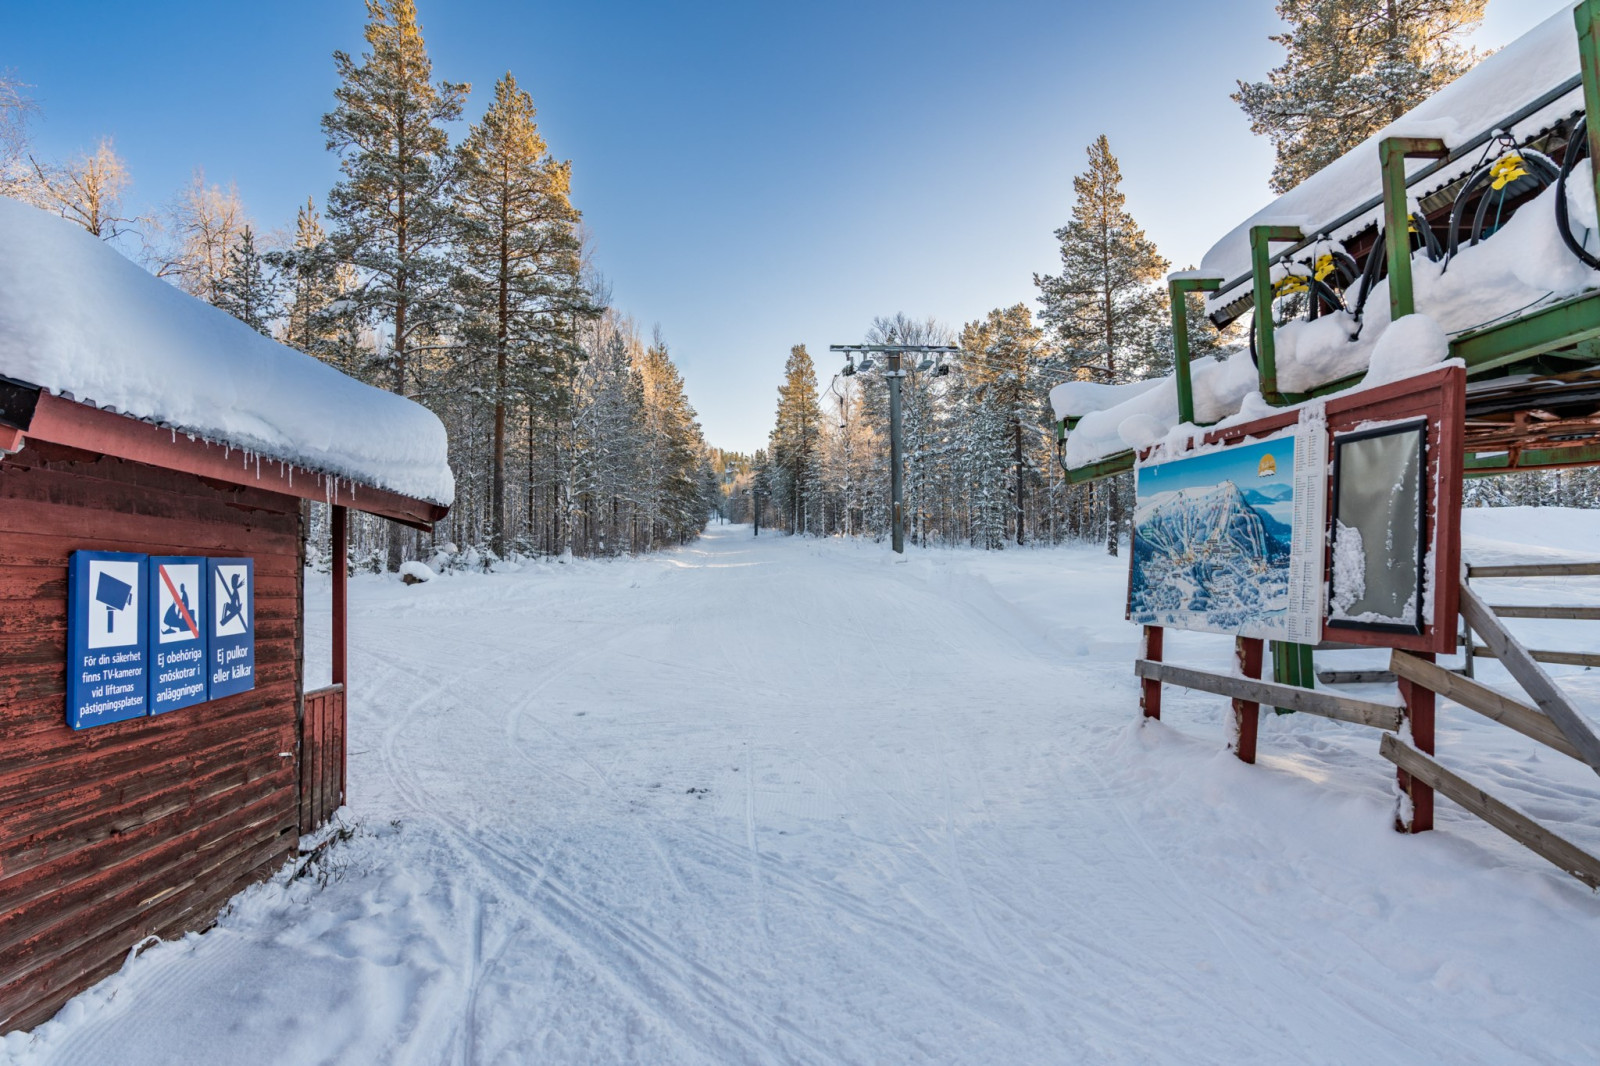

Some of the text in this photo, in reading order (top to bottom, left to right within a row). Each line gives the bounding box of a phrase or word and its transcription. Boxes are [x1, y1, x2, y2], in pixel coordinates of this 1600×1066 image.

[84, 651, 141, 667] För din säkerhet
[157, 648, 202, 668] Ej obehöriga
[217, 645, 248, 665] Ej pulkor
[82, 668, 142, 683] finns TV-kameror
[159, 667, 196, 683] snöskotrar
[213, 664, 252, 683] eller kälkar
[91, 684, 134, 698] vid liftarnas
[156, 683, 204, 702] anläggningen
[80, 696, 143, 718] påstigningsplatser
